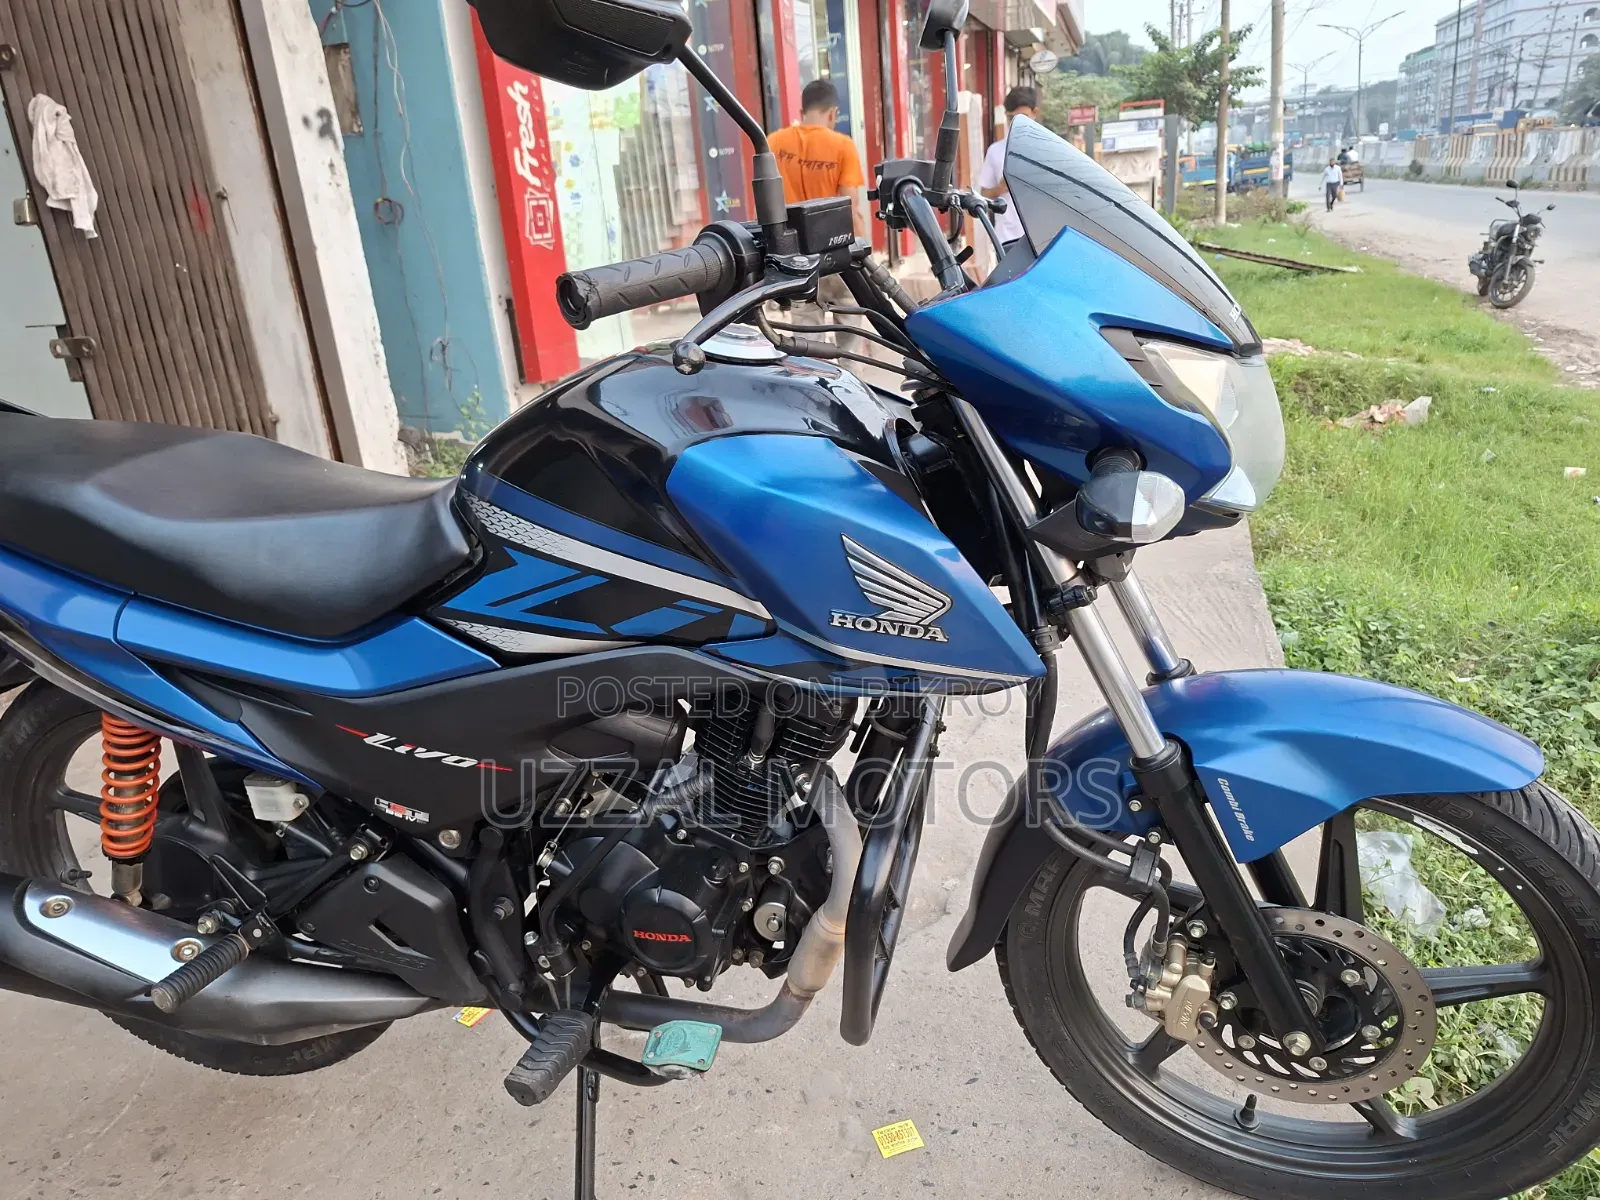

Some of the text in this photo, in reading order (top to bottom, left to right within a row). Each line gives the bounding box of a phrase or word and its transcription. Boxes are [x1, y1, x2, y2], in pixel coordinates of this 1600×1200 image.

[506, 80, 541, 187] Fresh
[829, 610, 949, 643] HONDA
[1217, 777, 1255, 842] Combi Brake
[633, 930, 692, 942] HONDA
[1543, 1088, 1600, 1156] MRF
